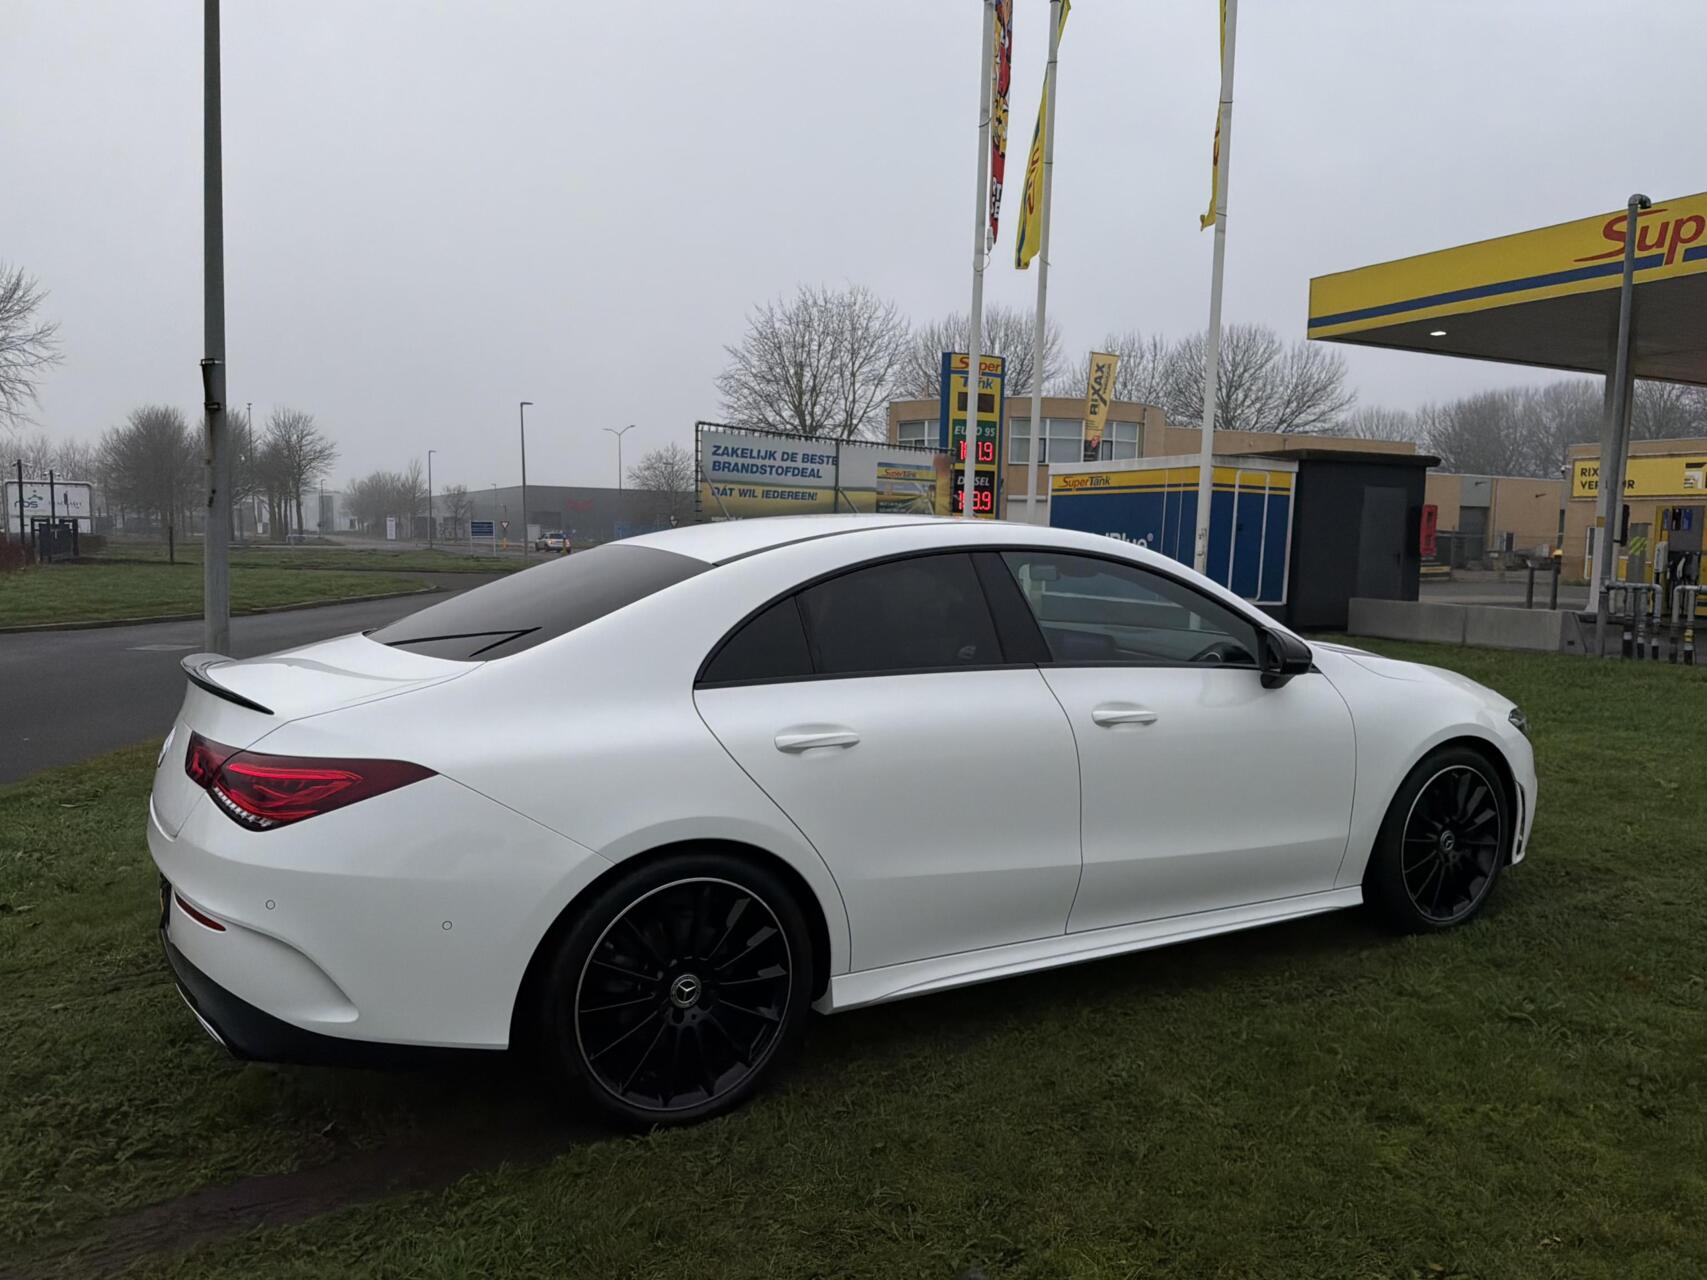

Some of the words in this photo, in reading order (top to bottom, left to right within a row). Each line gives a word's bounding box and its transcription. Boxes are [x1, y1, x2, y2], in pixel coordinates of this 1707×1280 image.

[952, 356, 1001, 375] Sper
[959, 375, 993, 389] Tnk
[954, 425, 983, 436] EUO
[985, 427, 996, 437] 95
[711, 445, 777, 461] ZAKELIJK
[781, 451, 798, 463] DE
[801, 453, 838, 466] BESTE
[712, 461, 823, 479] BRANDSTOFDEAL
[957, 475, 990, 486] DSEL
[738, 487, 759, 499] WIL
[761, 489, 818, 501] IEDEREEN!
